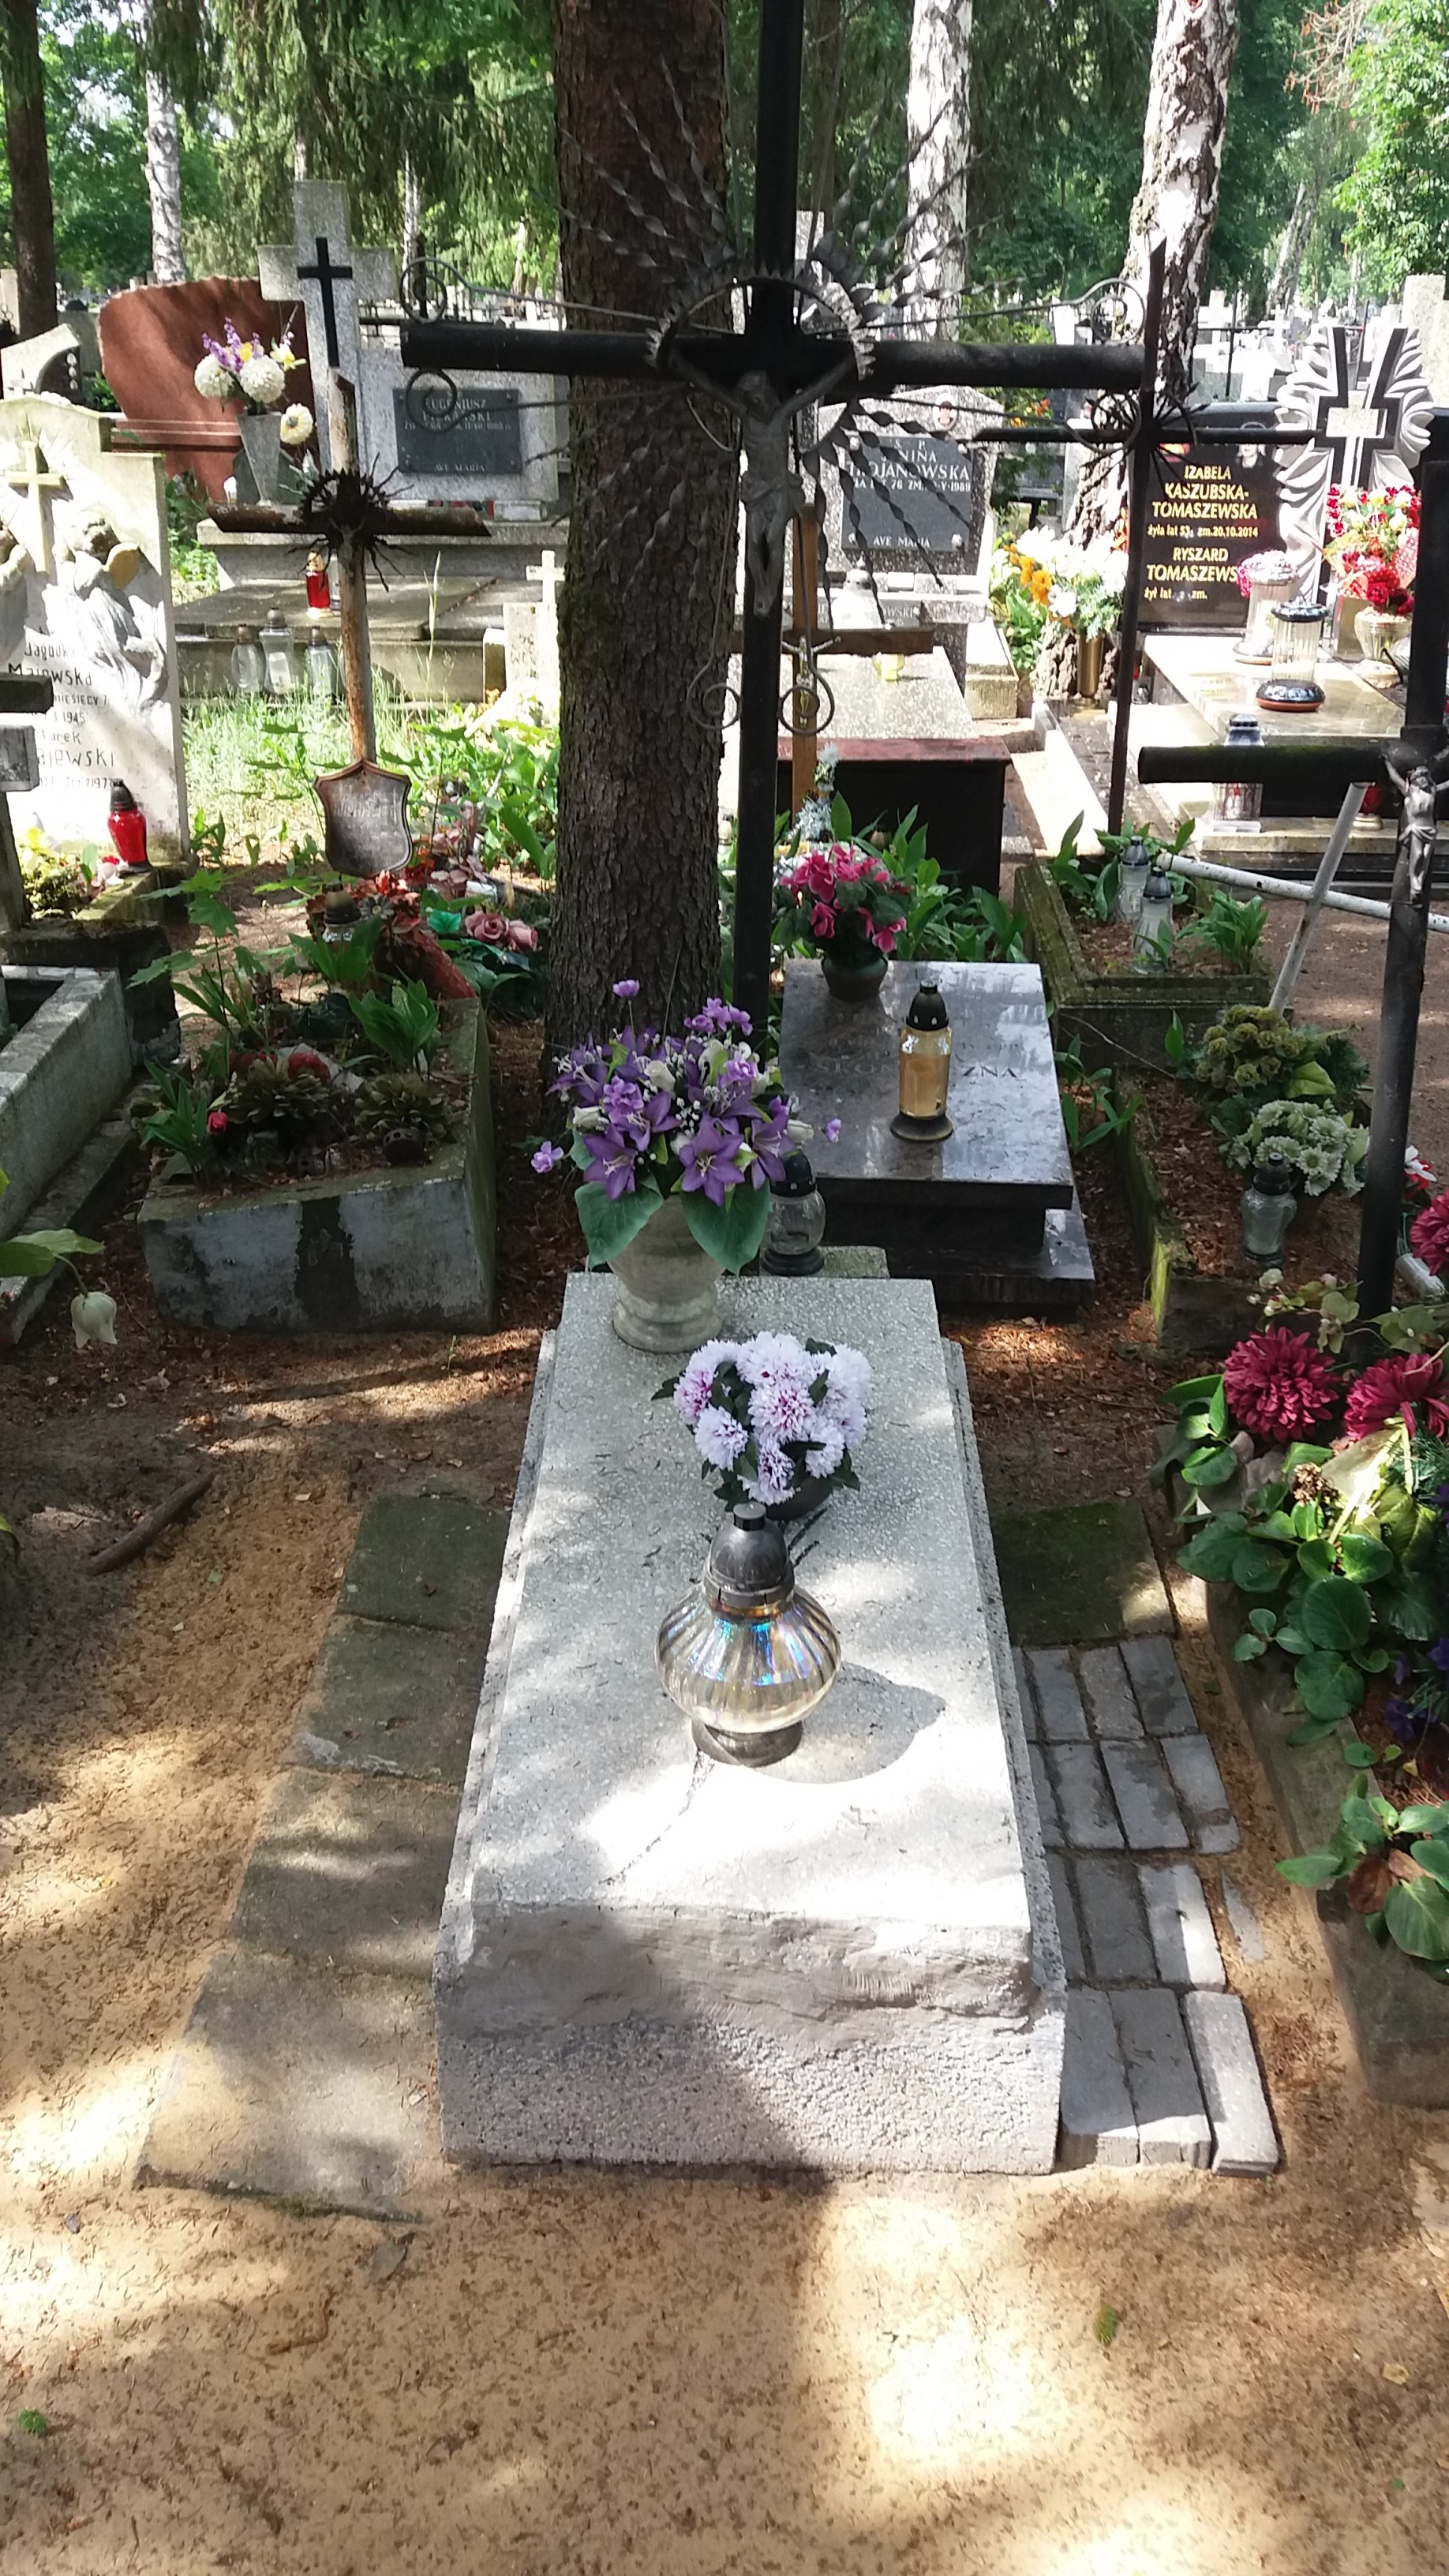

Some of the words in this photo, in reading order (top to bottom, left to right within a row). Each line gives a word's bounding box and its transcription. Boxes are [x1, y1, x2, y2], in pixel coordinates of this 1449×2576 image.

[881, 449, 937, 463] NINA
[1184, 464, 1232, 481] IZABELA
[1165, 482, 1249, 500] KASZUBSKA-
[1151, 501, 1258, 519] TOMASZEWSKA
[873, 535, 892, 546] AVE
[1173, 546, 1229, 562] RYSZARD
[1146, 564, 1238, 582] TOMASZEWS
[39, 747, 114, 769] ajewski
